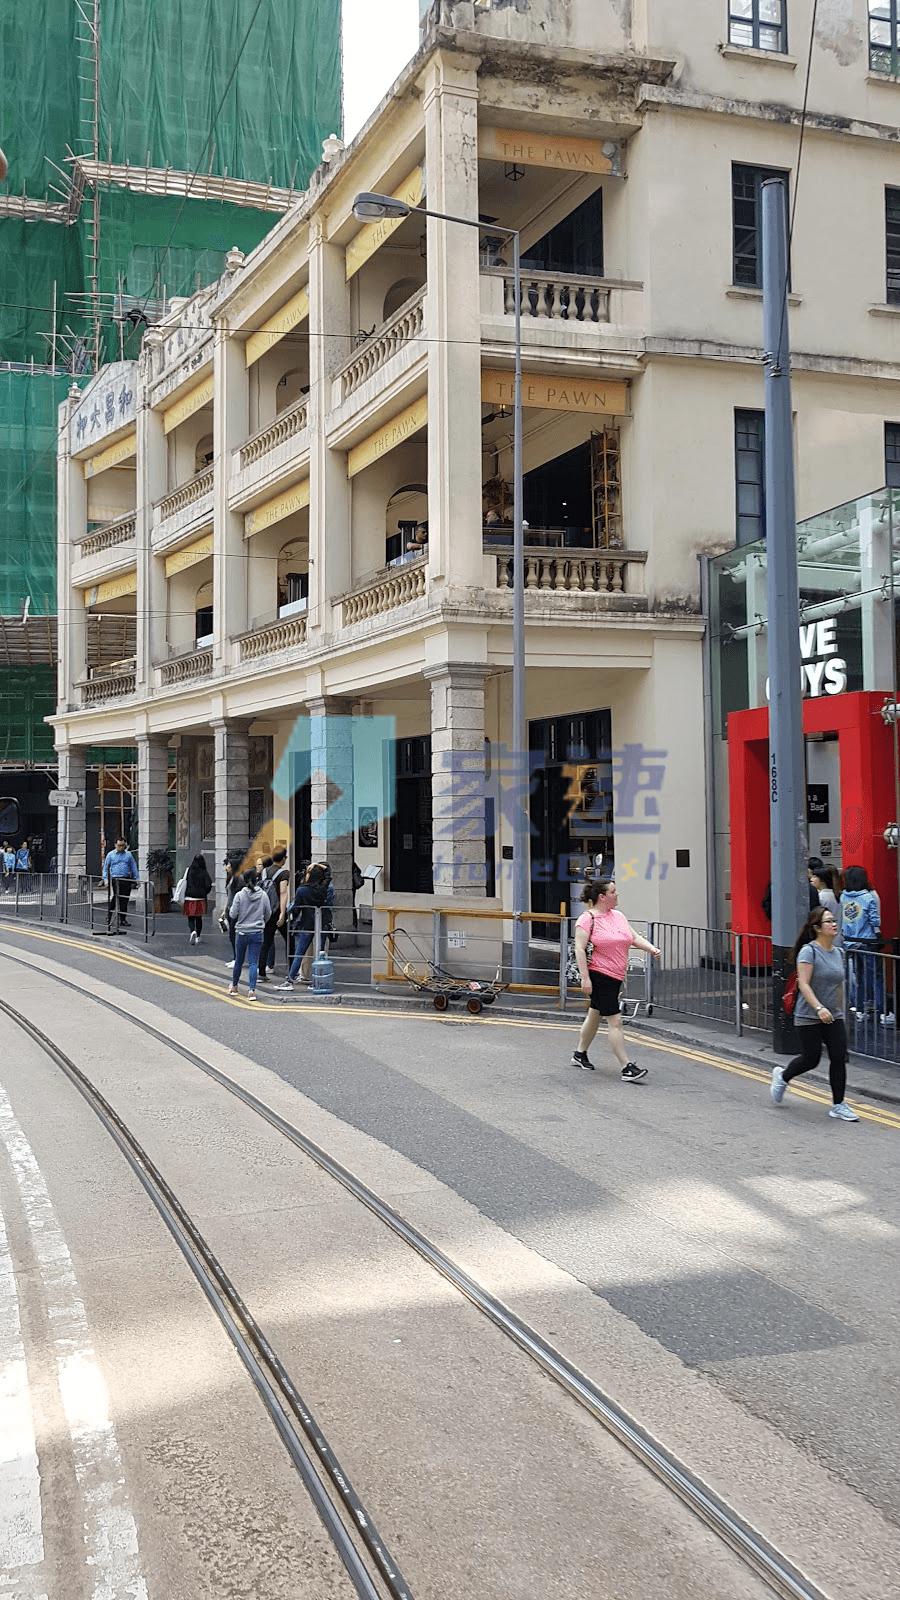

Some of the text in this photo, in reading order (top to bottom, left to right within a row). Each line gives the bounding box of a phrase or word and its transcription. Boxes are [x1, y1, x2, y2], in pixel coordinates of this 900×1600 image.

[501, 142, 595, 166] THE PAWN
[371, 222, 388, 246] THE
[547, 388, 607, 407] PAWN
[373, 415, 417, 455] THE PAWN
[265, 494, 302, 523] THE PAWN
[798, 618, 838, 659] VE
[766, 658, 847, 700] YS
[770, 752, 778, 803] 168C
